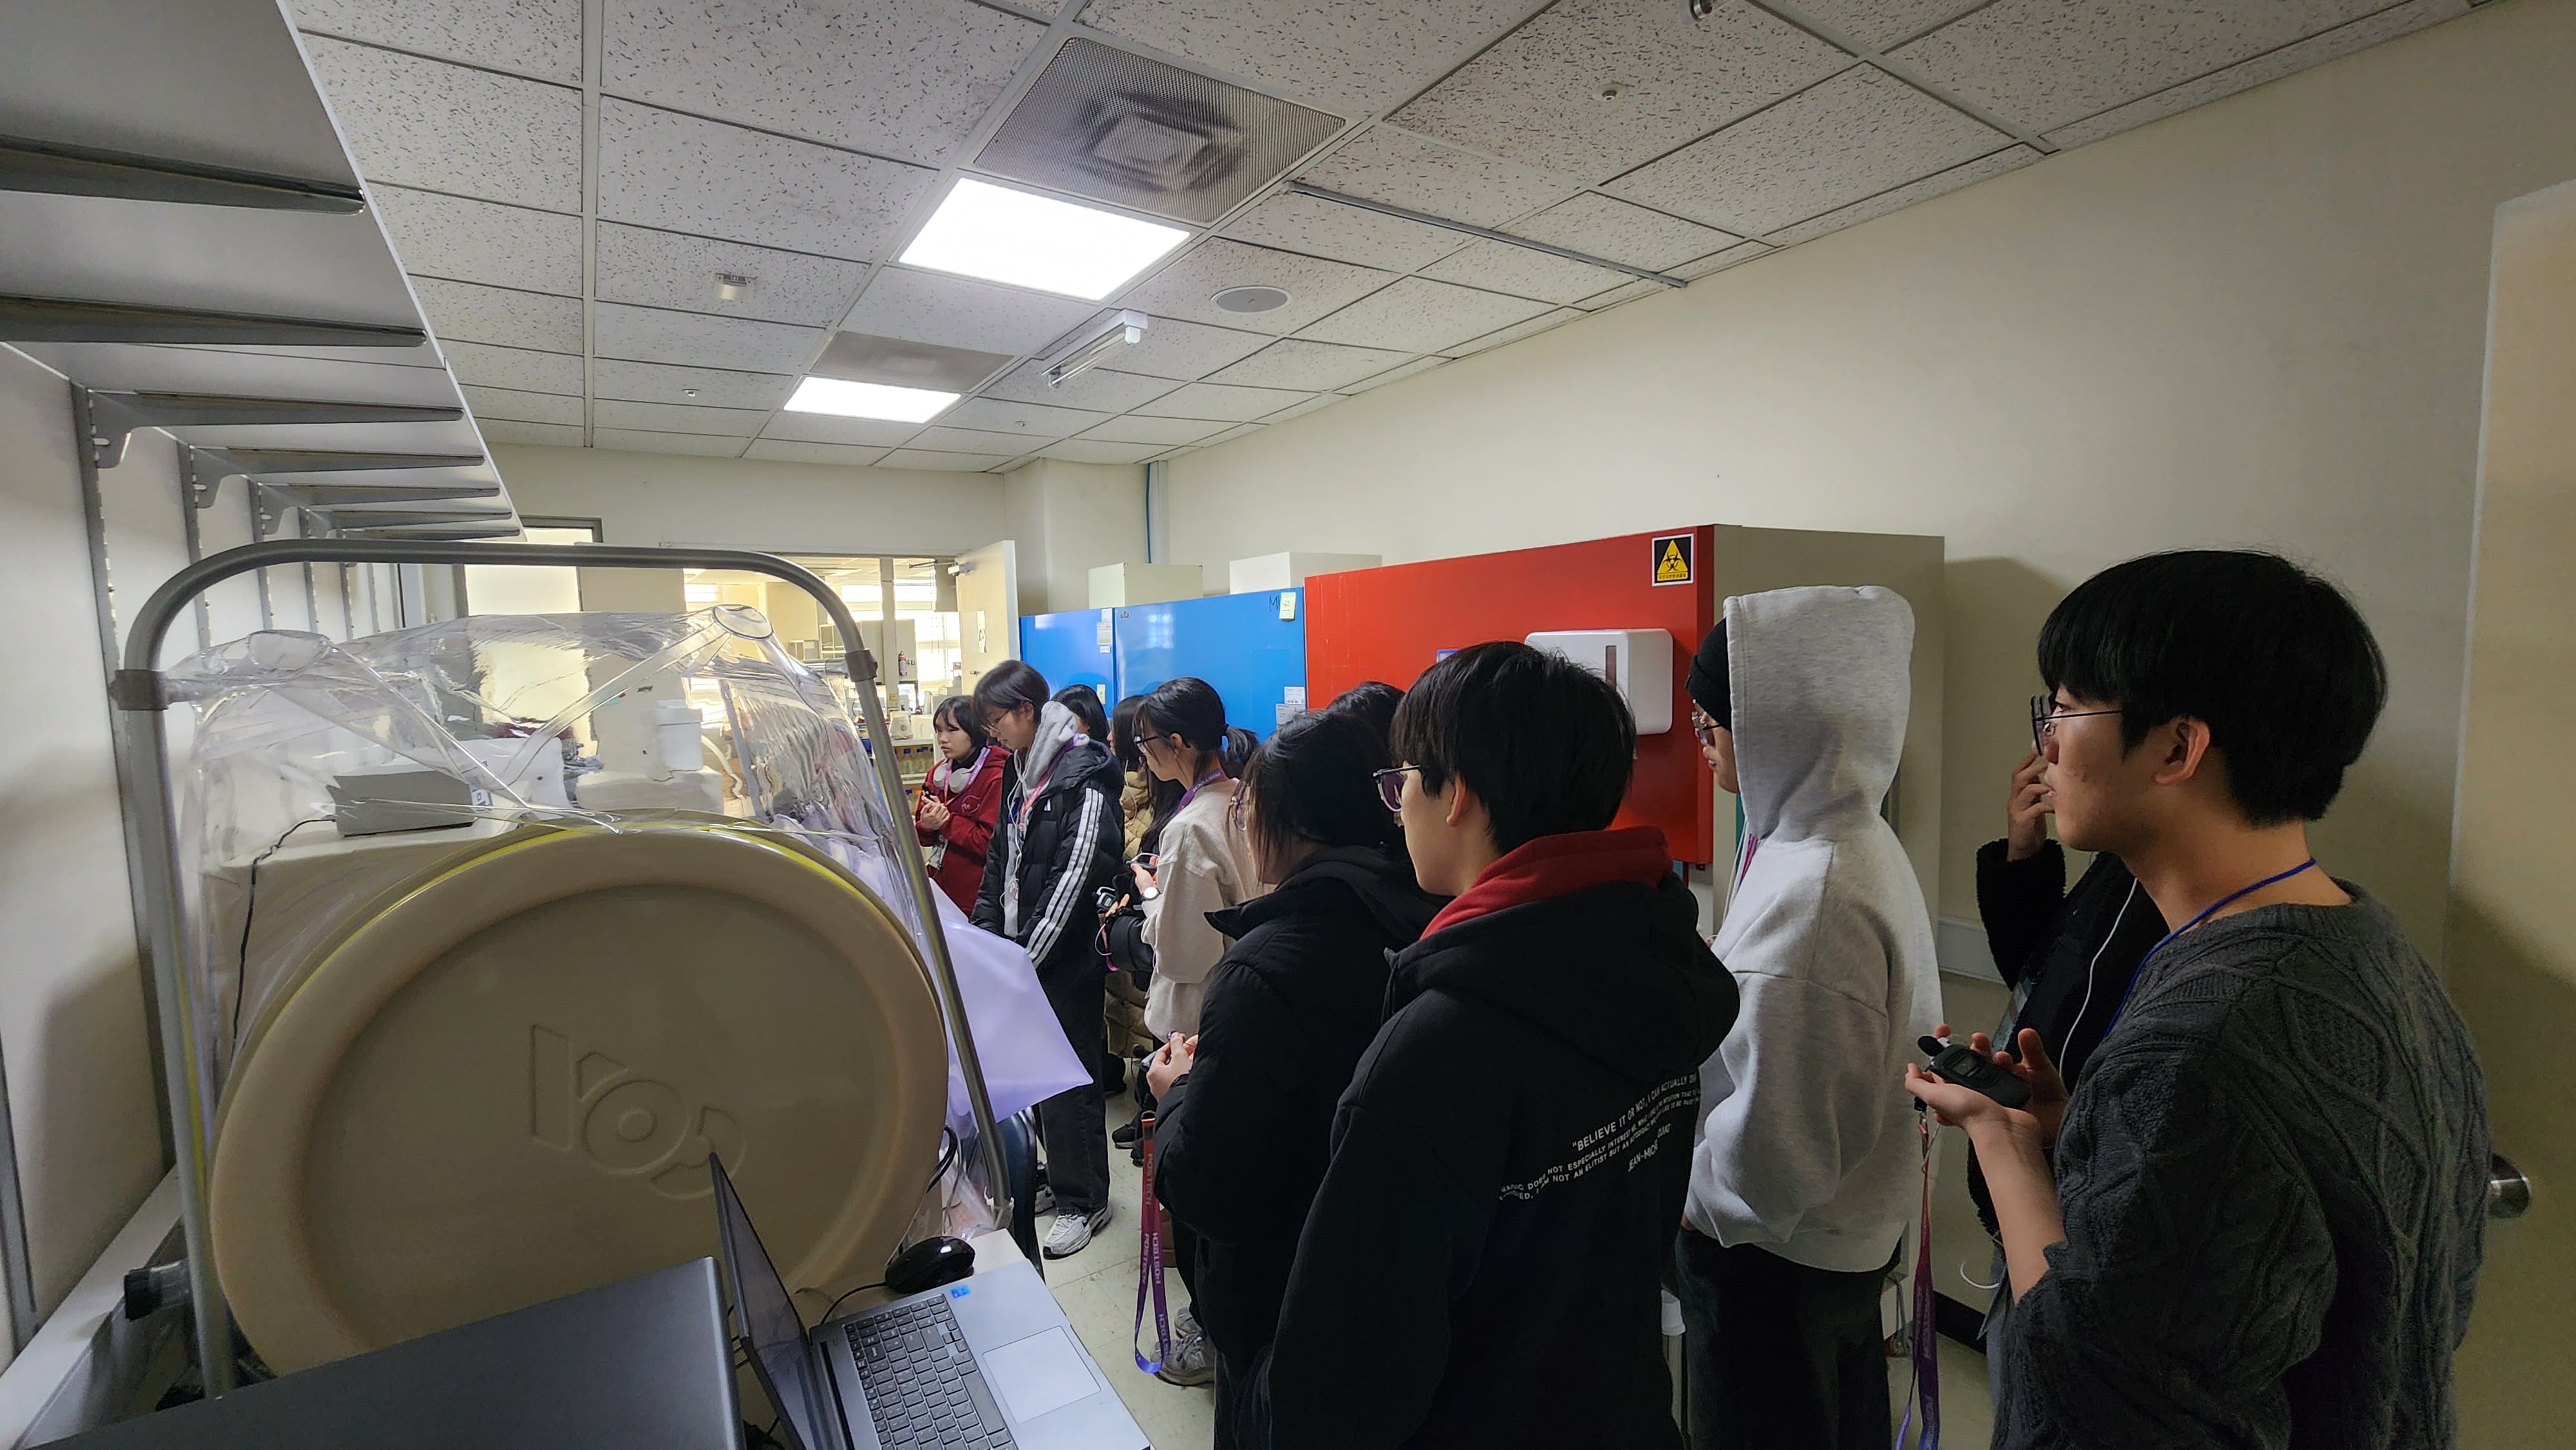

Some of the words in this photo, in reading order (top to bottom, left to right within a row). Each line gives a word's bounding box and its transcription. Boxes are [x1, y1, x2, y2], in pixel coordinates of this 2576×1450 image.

[1619, 1115, 1625, 1127] IT
[1627, 1107, 1634, 1120] OR
[1636, 1097, 1648, 1113] NOT,
[1651, 1086, 1660, 1100] CAN
[1661, 1075, 1687, 1091] ACTUALLY
[1547, 1165, 1563, 1175] NOT
[1567, 1145, 1605, 1171] ESPECIALLY
[1608, 1129, 1630, 1149] INTEREST
[1552, 1174, 1569, 1182] NOT
[1573, 1167, 1583, 1179] AN
[1585, 1153, 1607, 1172] ELITIST
[1609, 1145, 1620, 1157] BUT
[1622, 1140, 1629, 1151] AN
[1145, 1153, 1154, 1205] POSTECH
[1152, 1232, 1161, 1284] POSTECH
